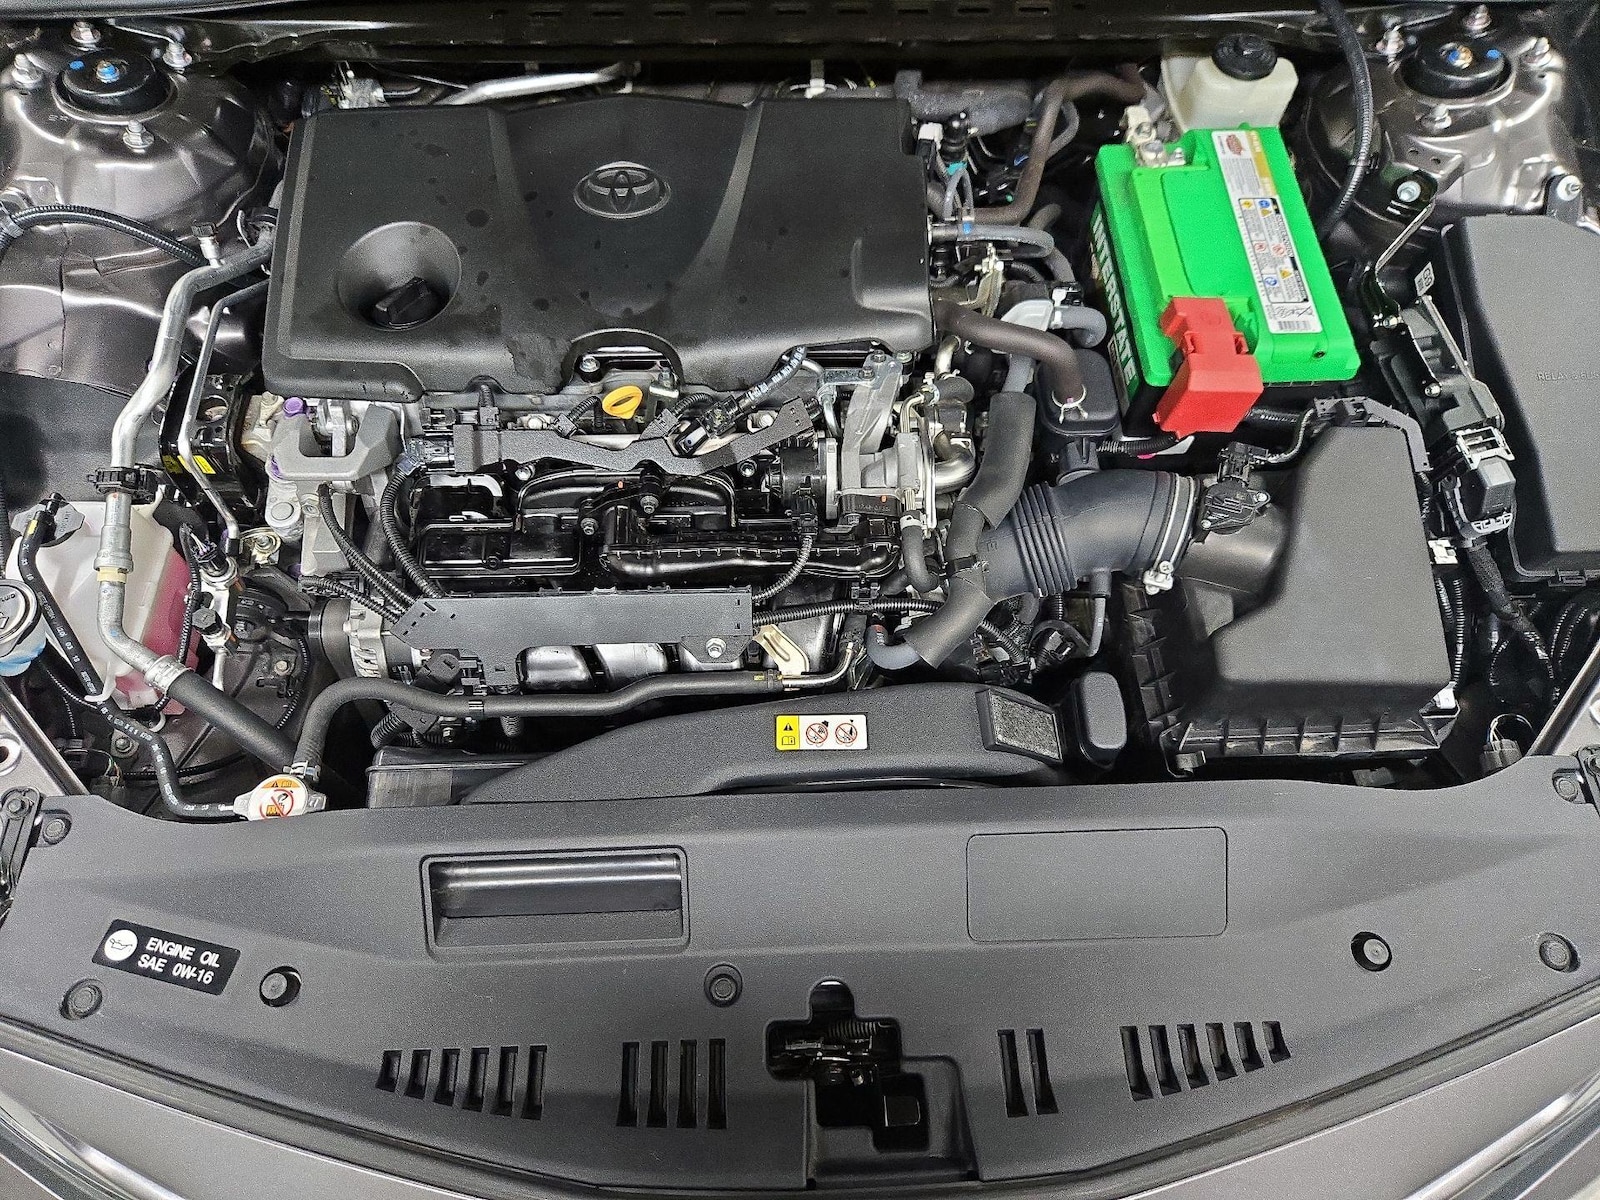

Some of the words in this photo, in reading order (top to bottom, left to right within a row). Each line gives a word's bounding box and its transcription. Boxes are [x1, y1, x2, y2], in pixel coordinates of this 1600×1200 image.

[1092, 213, 1136, 386] INTERSTATE
[1536, 371, 1568, 381] RELAY
[146, 937, 195, 961] ENGINE
[200, 951, 220, 967] OIL
[138, 954, 167, 972] SAE
[172, 963, 214, 984] 0W-16
